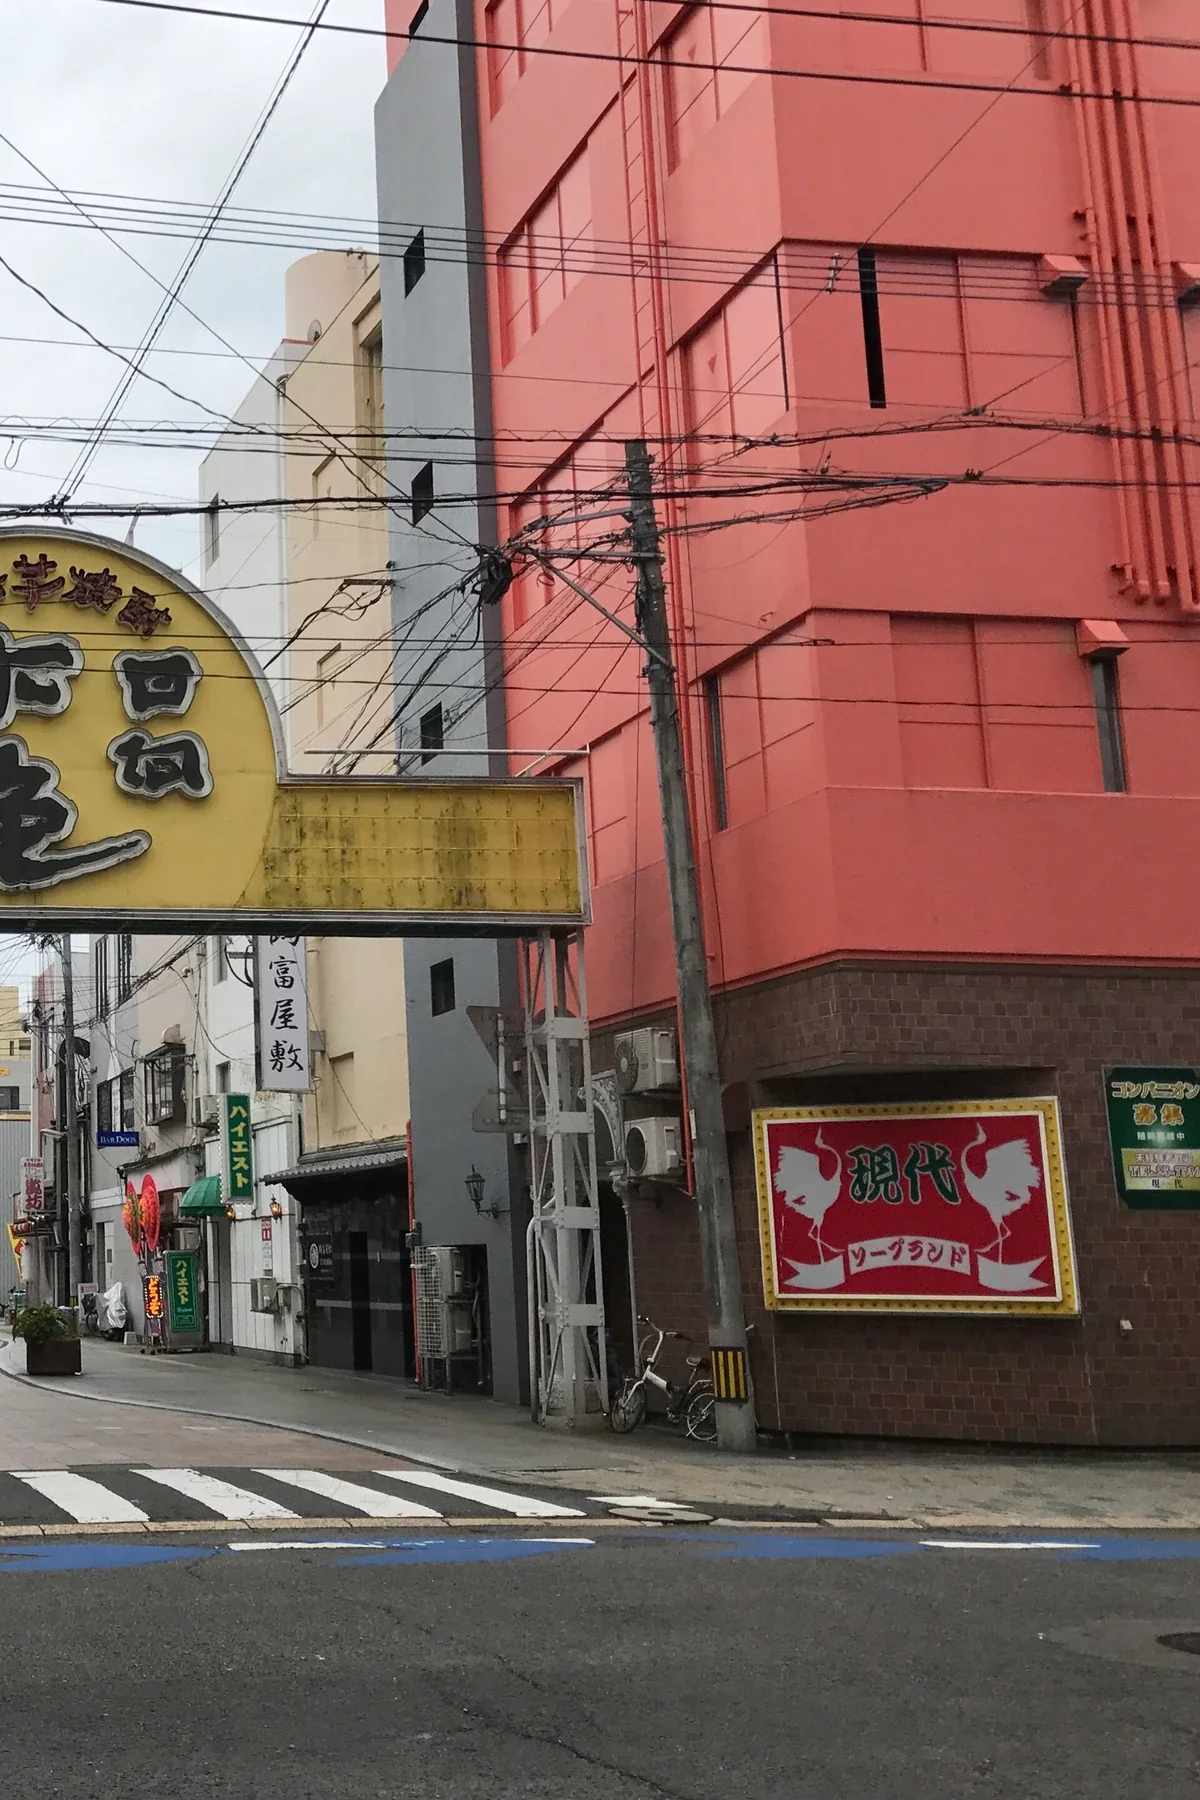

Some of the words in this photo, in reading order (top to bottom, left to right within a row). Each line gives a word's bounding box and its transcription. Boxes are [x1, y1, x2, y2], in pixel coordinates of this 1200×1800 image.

[1111, 1081, 1200, 1099] コンパニオン
[229, 1104, 250, 1189] ハイエスト
[847, 1143, 961, 1205] 現代
[850, 1240, 968, 1270] ソープランド
[148, 1278, 161, 1315] どうぞ
[175, 1259, 189, 1305] ハイエスト
